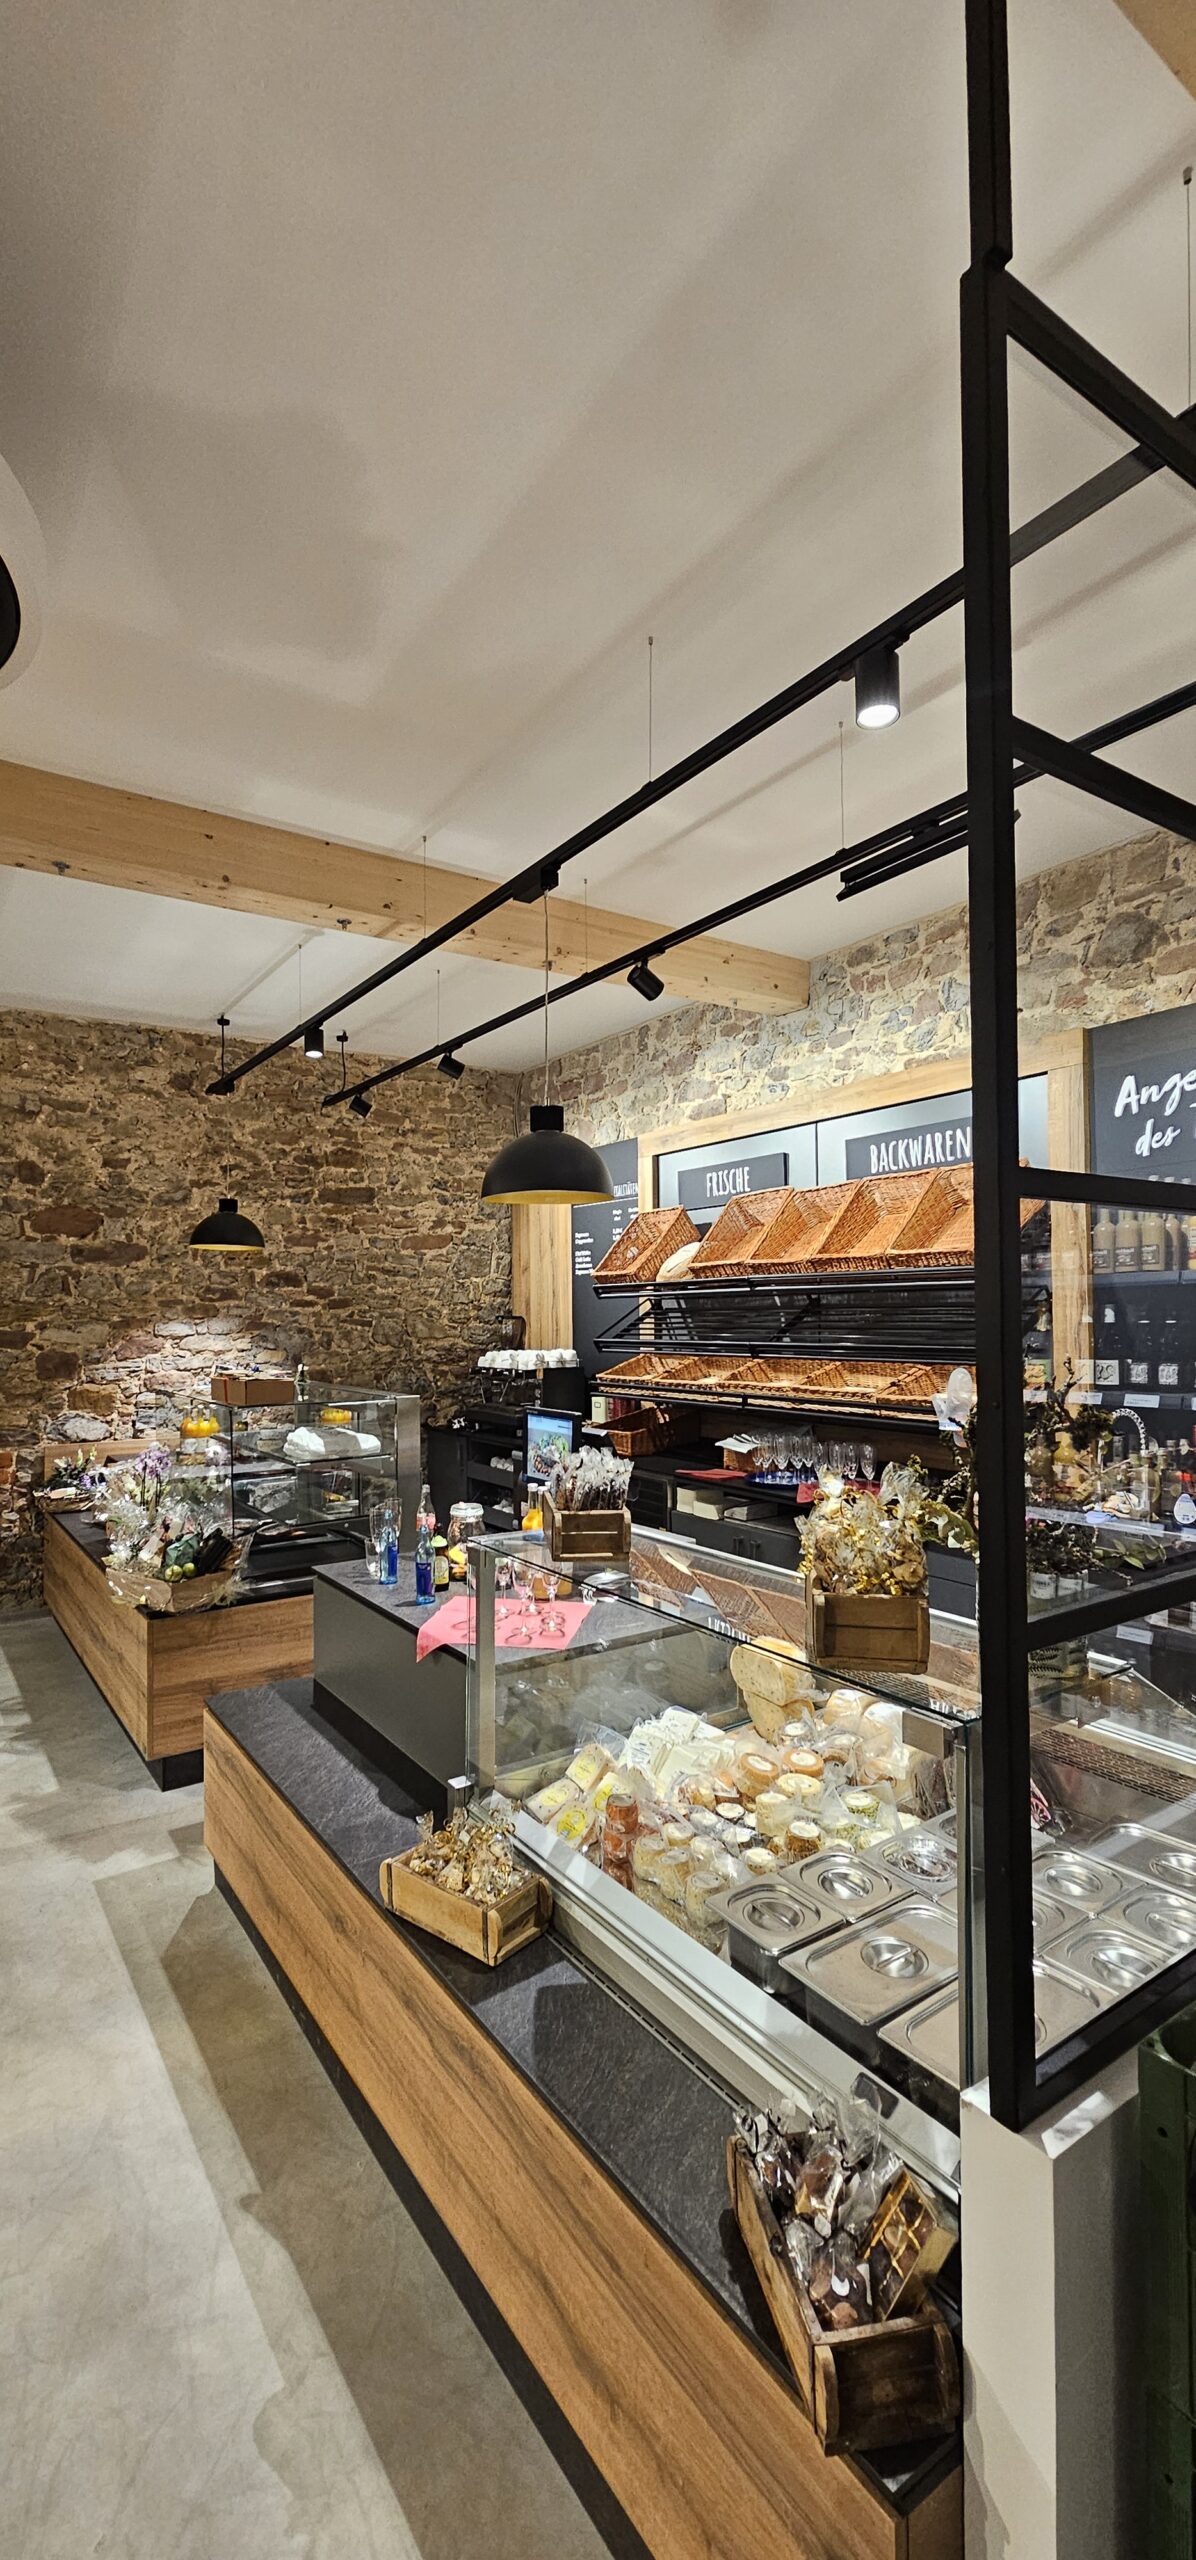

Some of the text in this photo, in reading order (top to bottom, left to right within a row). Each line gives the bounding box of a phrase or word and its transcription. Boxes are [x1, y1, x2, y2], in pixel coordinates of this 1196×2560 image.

[869, 1126, 972, 1174] BACKWAREN
[1135, 1118, 1181, 1157] des
[706, 1166, 751, 1198] FRISCHE
